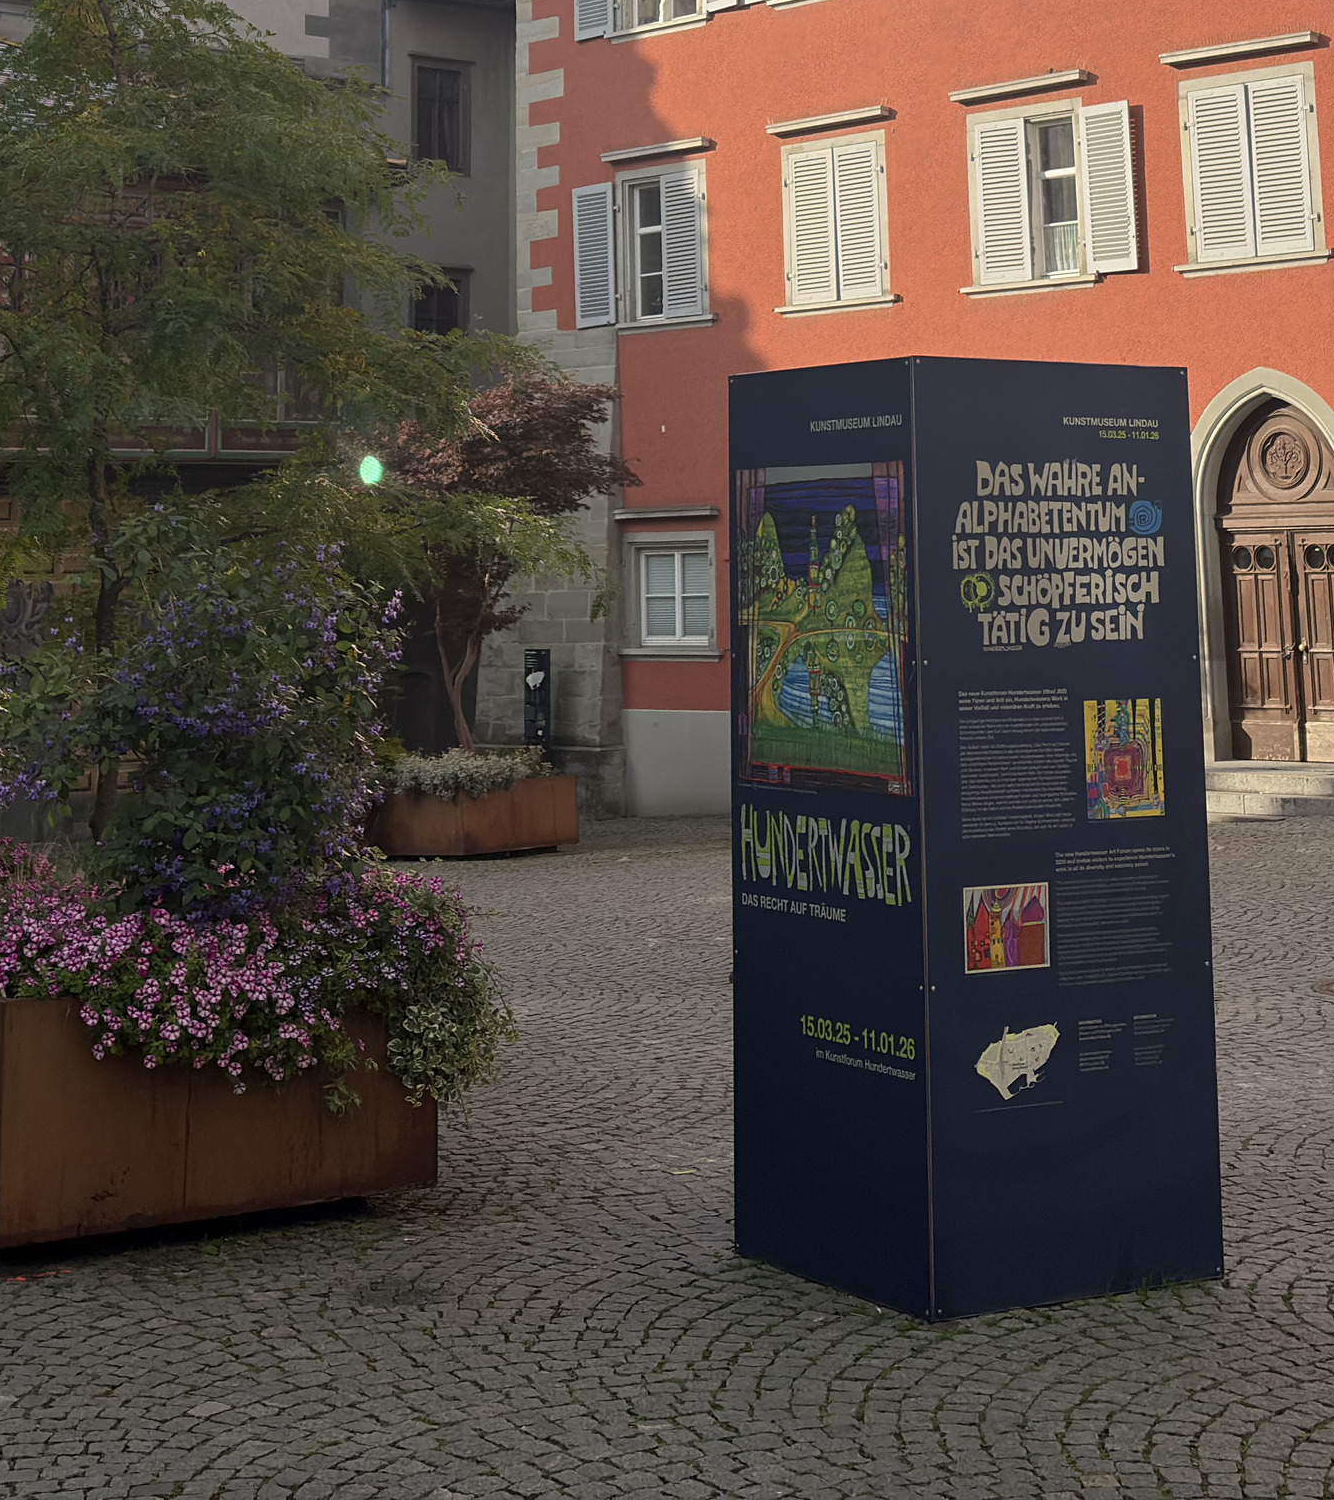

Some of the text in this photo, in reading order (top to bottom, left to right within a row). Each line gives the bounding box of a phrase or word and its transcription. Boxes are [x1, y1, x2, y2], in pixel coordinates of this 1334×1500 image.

[810, 414, 902, 432] KUNSTMUSEUM LINDAU
[1062, 416, 1159, 428] KUNSTMUSEUM LINDAU
[1098, 430, 1127, 439] 15.03.25
[1132, 431, 1160, 440] 11.01.26
[976, 458, 1146, 497] DAS WAHRE AN-
[955, 500, 1127, 534] ALPHABETENTUM
[984, 536, 1023, 570] DAS
[1026, 536, 1165, 570] UNVERMÖGEN
[1053, 610, 1086, 649] ZU
[740, 803, 912, 907] HUNDERTWASSER
[741, 892, 847, 922] DAS RECHT AUF TRÄUME
[800, 1015, 851, 1045] 15.03.25
[862, 1028, 915, 1060] 11.01.26
[815, 1047, 917, 1080] im Kunstforum Hundertwasser
